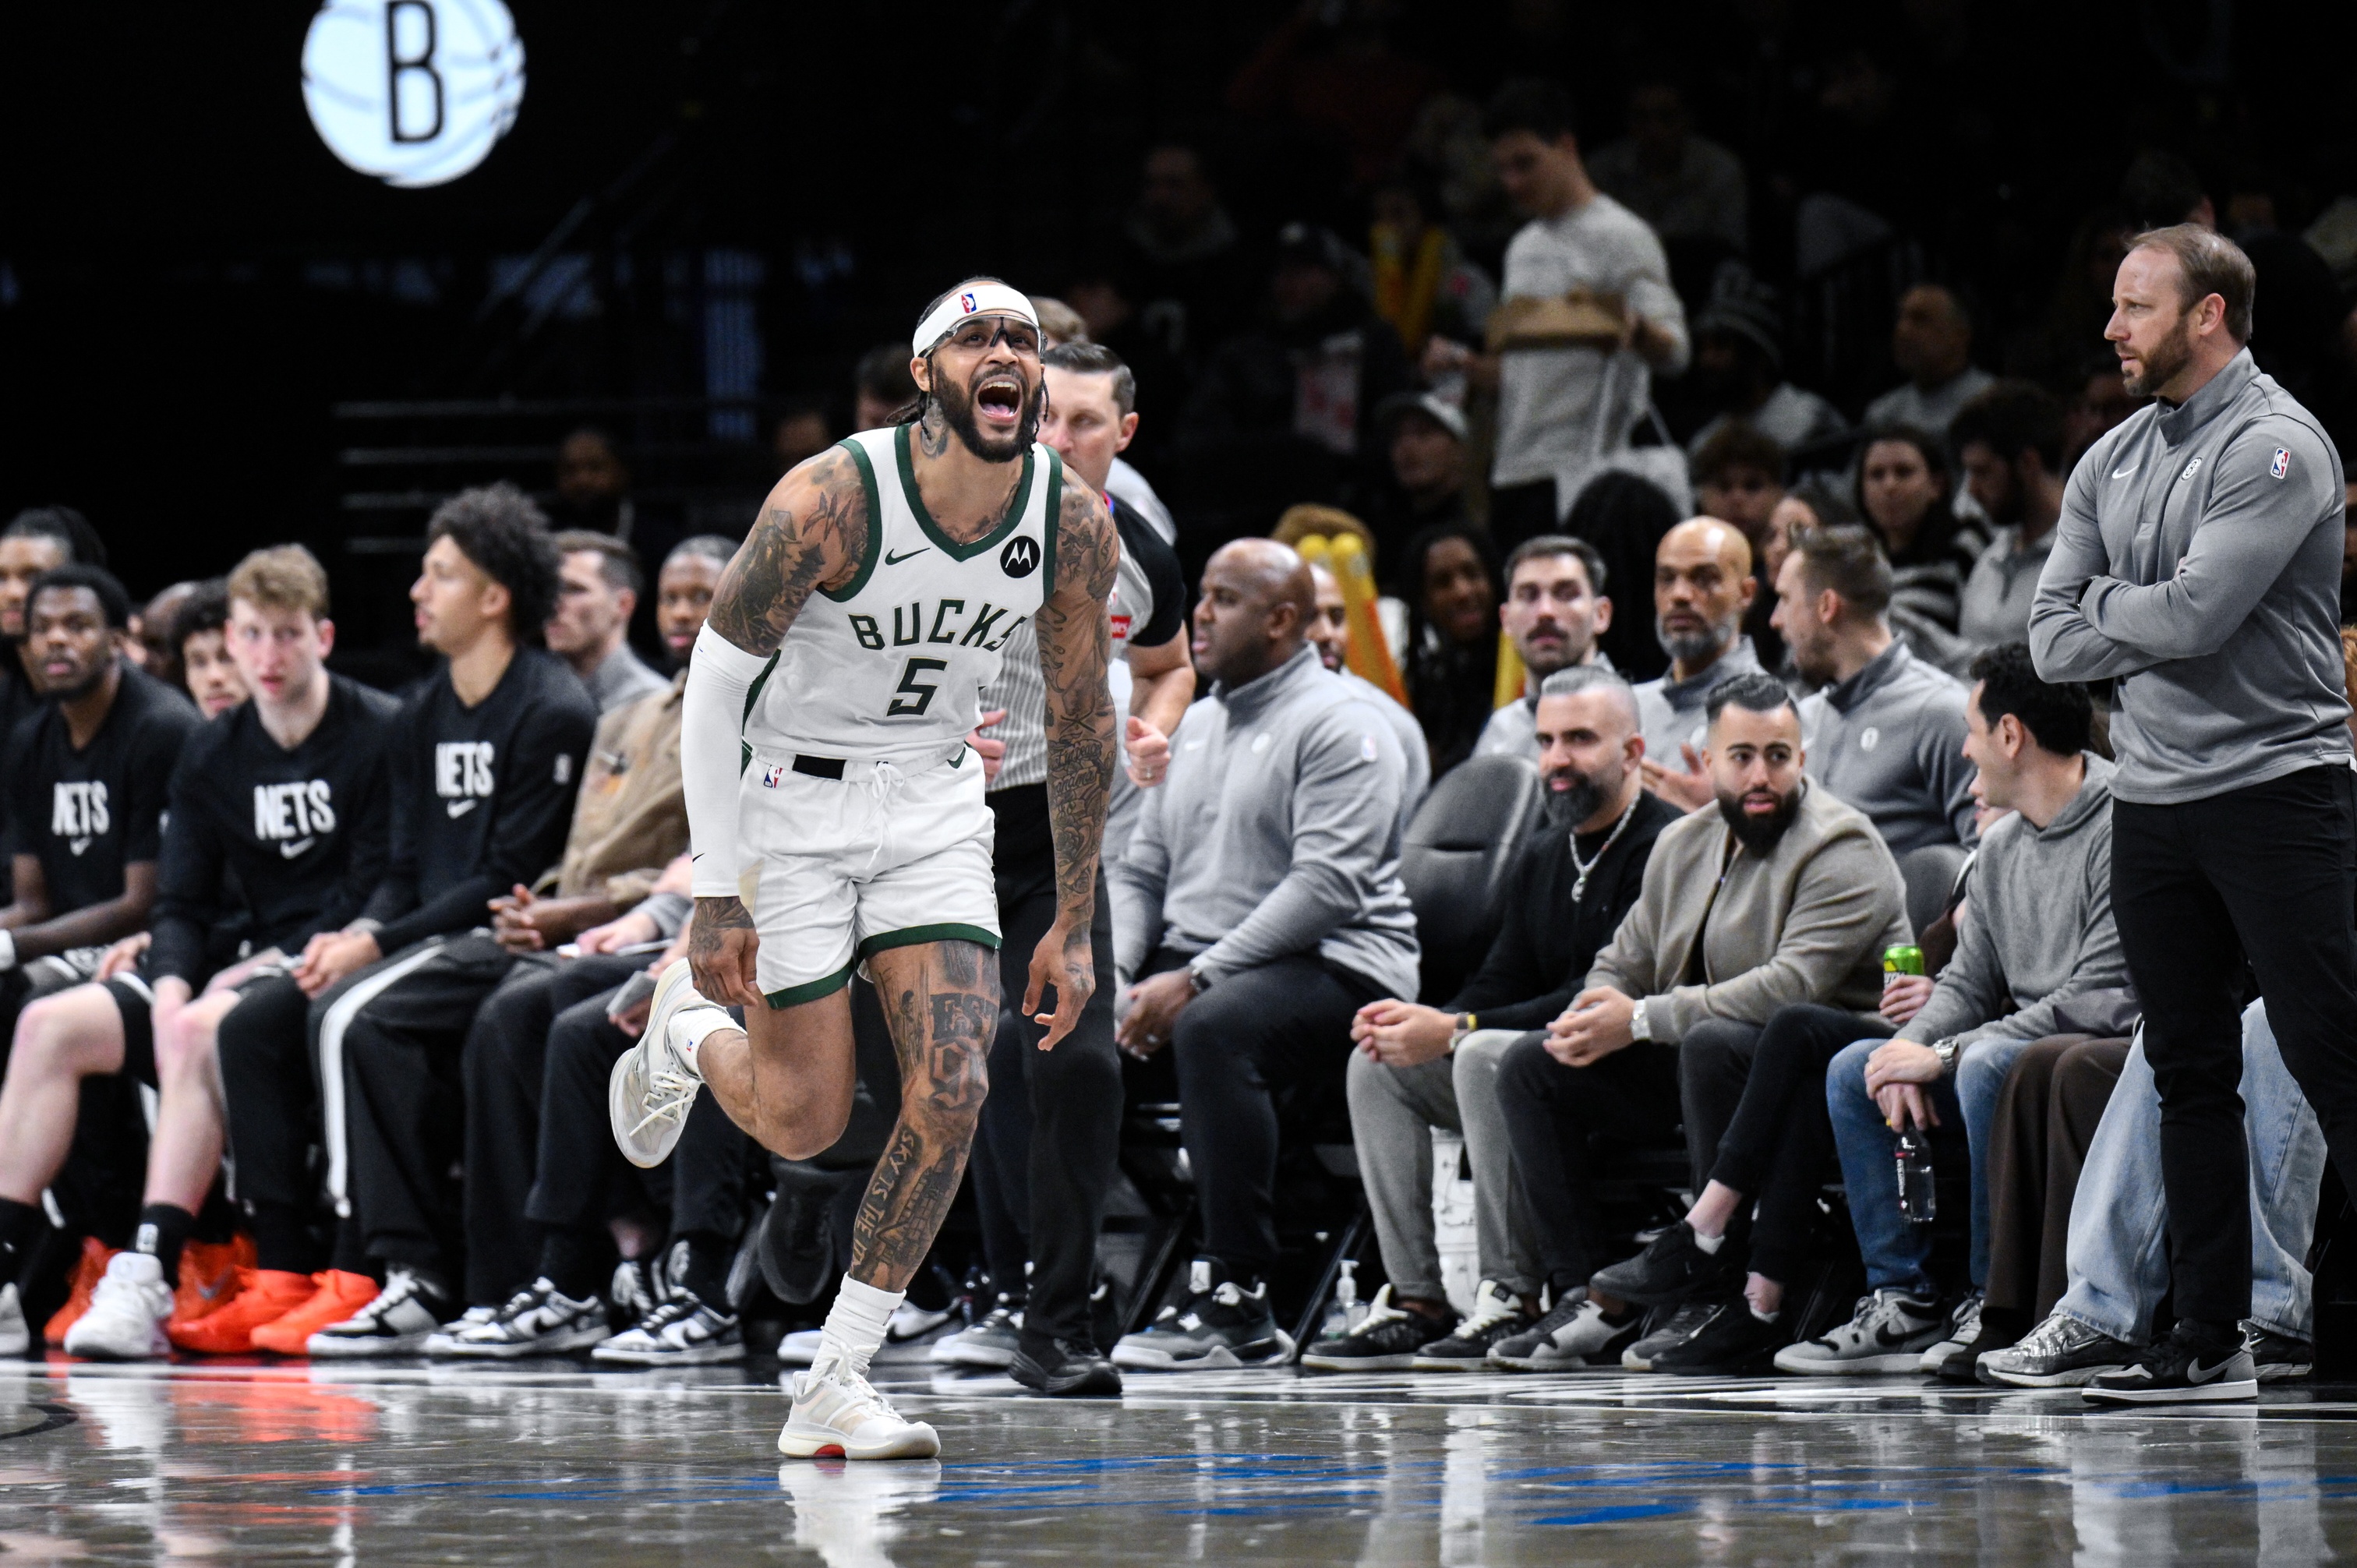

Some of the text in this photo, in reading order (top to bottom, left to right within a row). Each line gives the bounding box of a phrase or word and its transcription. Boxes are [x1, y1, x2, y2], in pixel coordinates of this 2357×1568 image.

[385, 0, 443, 143] B
[847, 599, 1028, 652] BUCKS
[886, 656, 949, 717] 5
[51, 780, 110, 835] NETS
[253, 779, 337, 840] NETS
[889, 1129, 914, 1176] SKY
[871, 1172, 896, 1202] IS
[856, 1202, 886, 1240] THE
